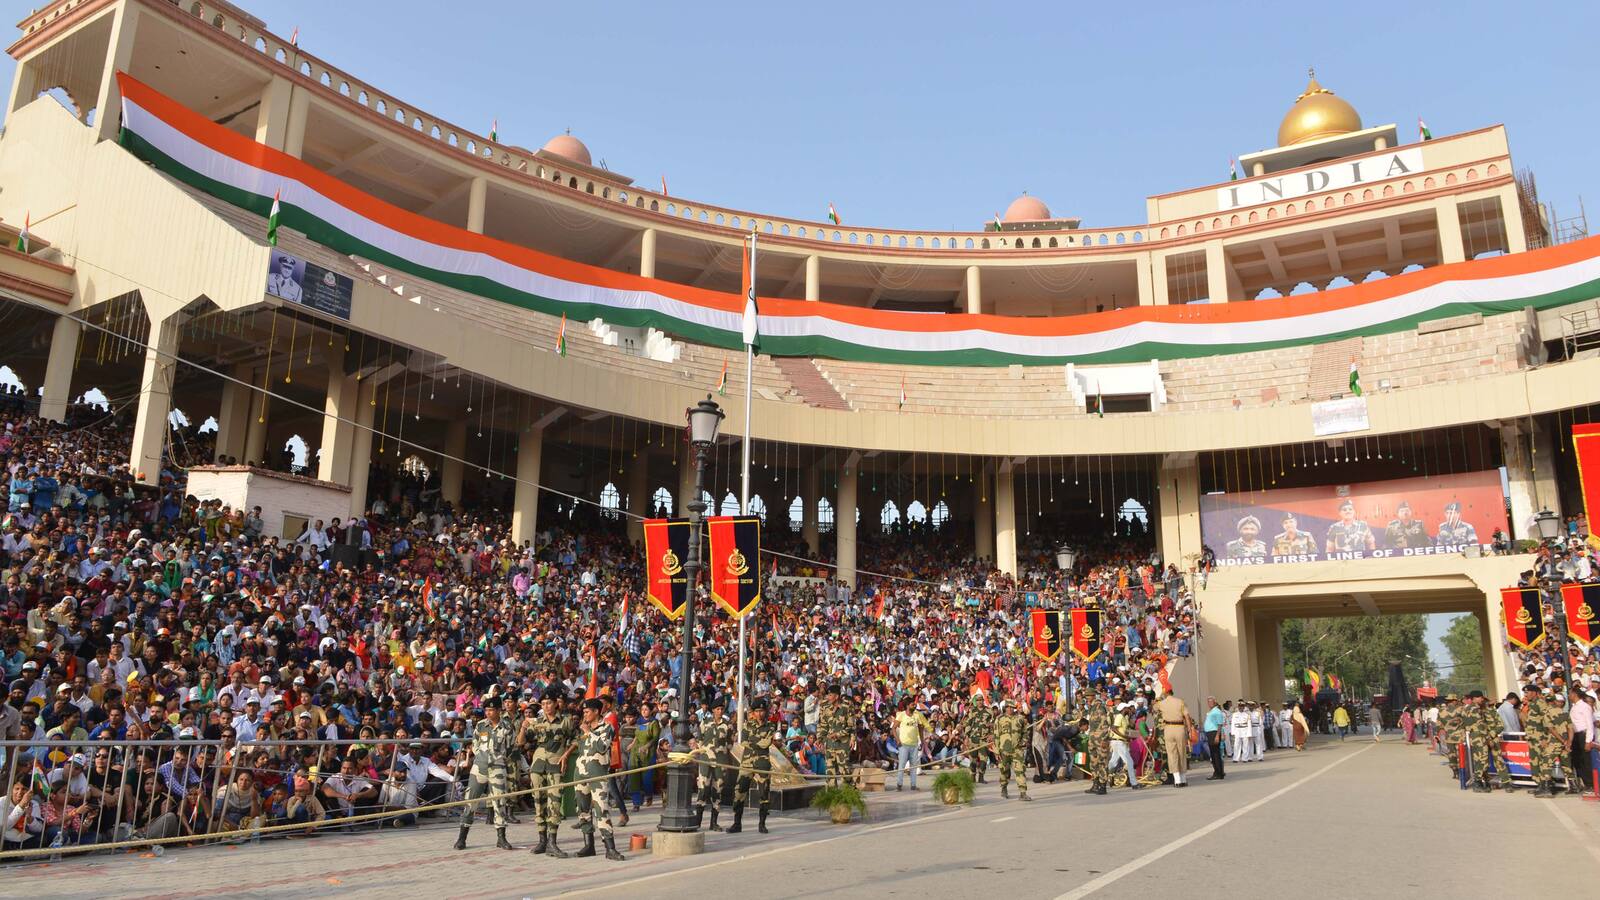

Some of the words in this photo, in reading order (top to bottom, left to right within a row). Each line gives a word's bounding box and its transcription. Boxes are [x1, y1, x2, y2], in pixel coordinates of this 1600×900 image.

[1228, 154, 1411, 207] INDIA
[1216, 556, 1265, 567] NDIA'S
[1273, 554, 1318, 564] FIRST
[1327, 551, 1364, 561] LINE
[1372, 549, 1394, 558] OF
[1403, 543, 1480, 556] DEFENC
